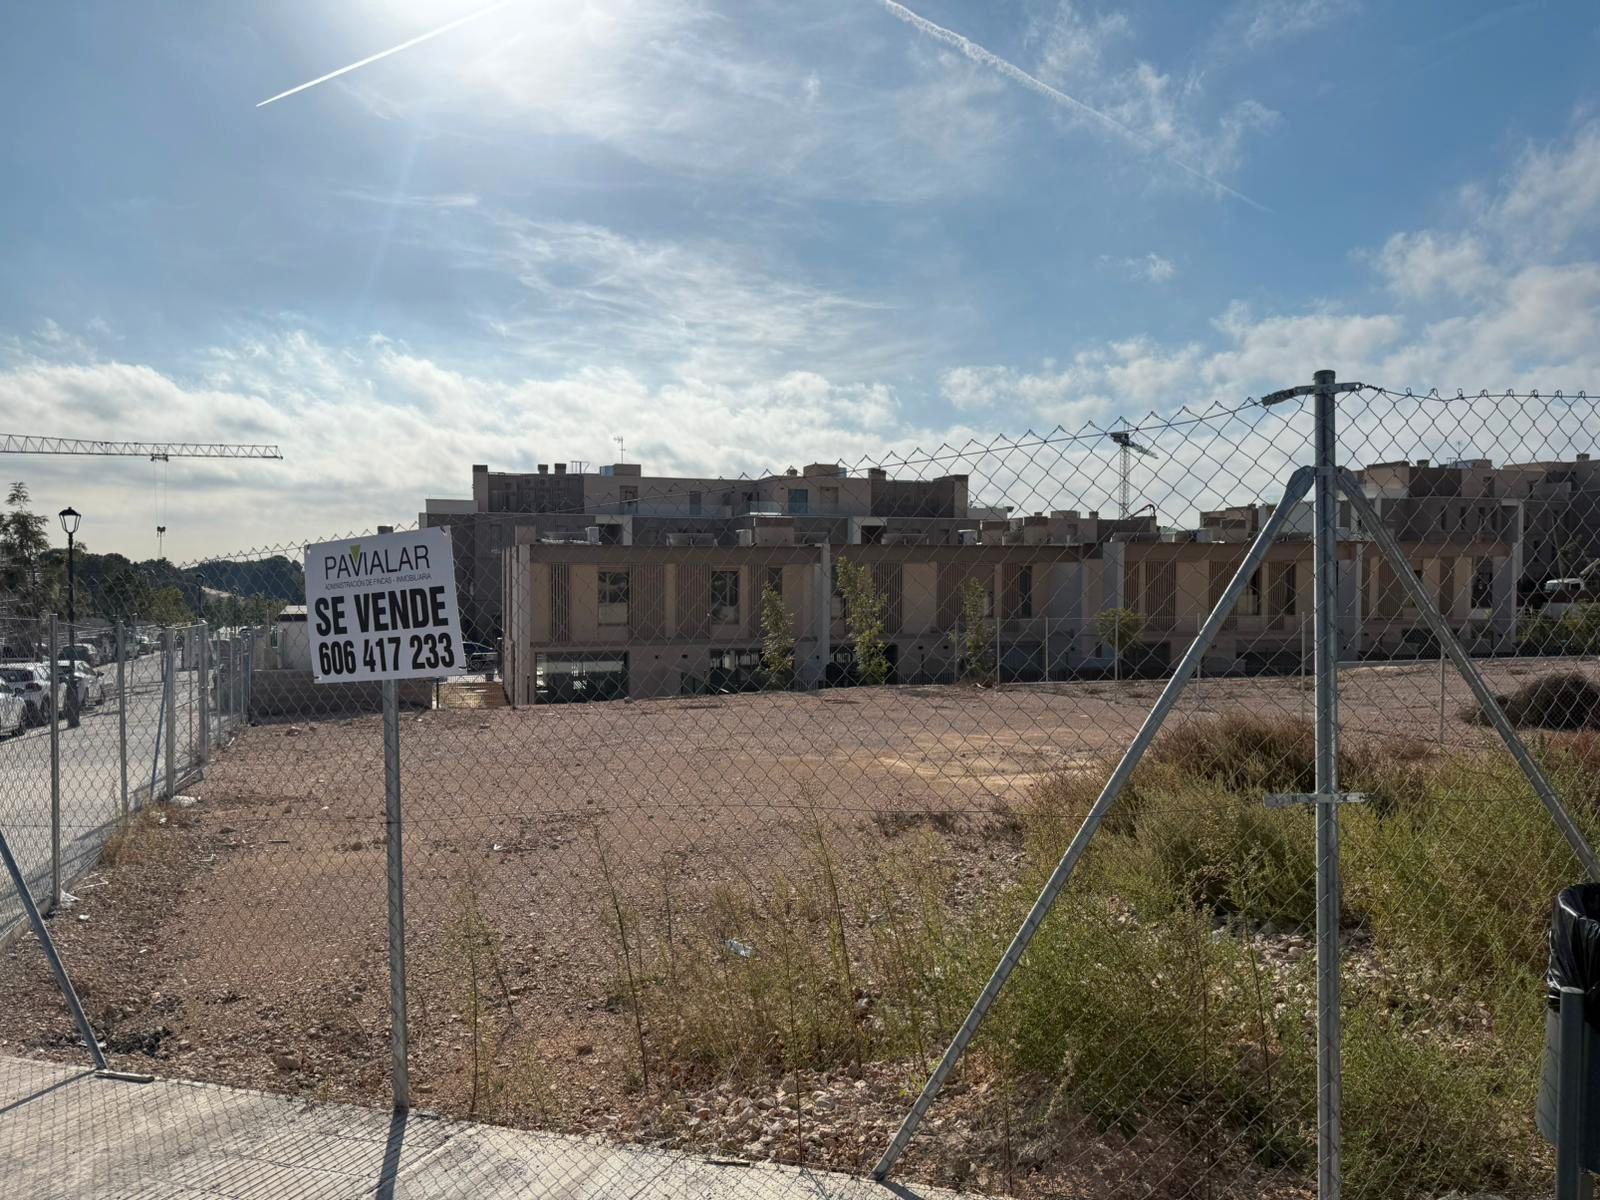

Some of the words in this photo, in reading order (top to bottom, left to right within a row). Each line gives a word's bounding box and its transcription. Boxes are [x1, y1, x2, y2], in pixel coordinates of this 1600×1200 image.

[324, 544, 430, 580] PAVIALAR
[315, 596, 348, 636] SE
[354, 585, 448, 633] VENDE
[318, 640, 356, 675] 606
[363, 636, 401, 672] 417
[410, 632, 455, 670] 233
